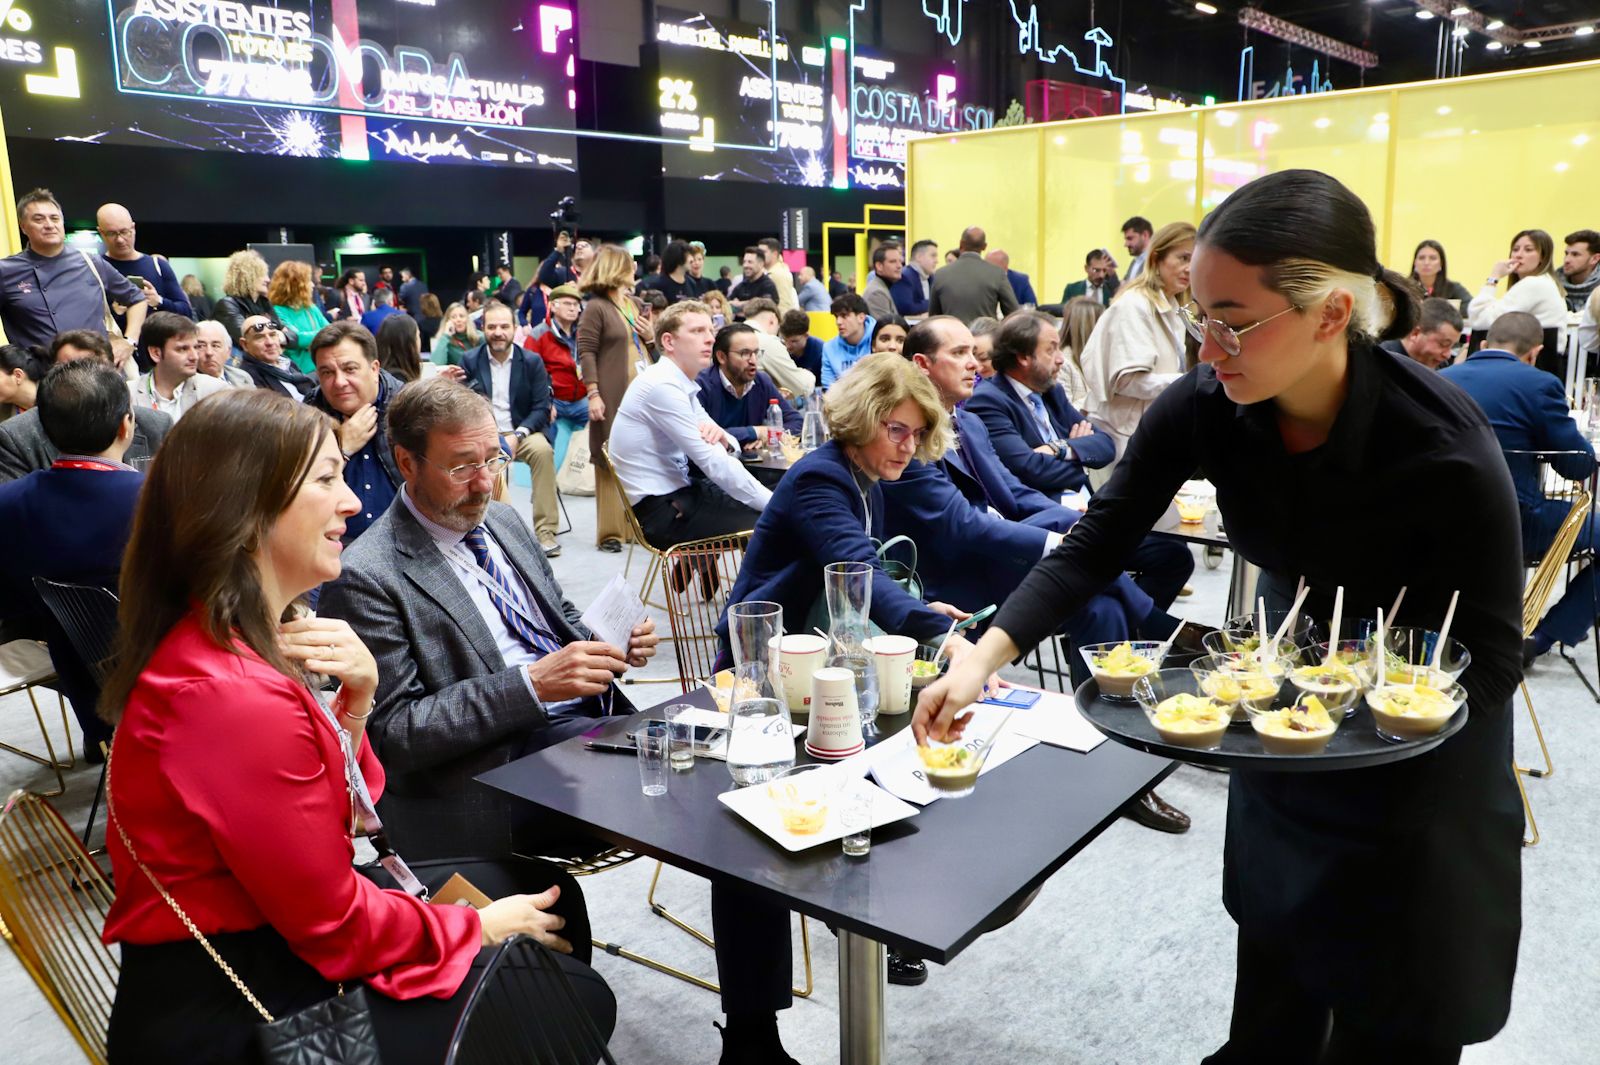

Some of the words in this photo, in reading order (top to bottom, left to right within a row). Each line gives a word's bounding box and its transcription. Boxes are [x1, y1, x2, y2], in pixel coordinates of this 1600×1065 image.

[453, 78, 544, 105] ACTUALES
[658, 77, 697, 111] 2%
[855, 86, 923, 124] COSTA
[384, 94, 423, 116] DEL
[432, 98, 523, 126] PABELLÓN
[795, 209, 804, 250] MARBELLA
